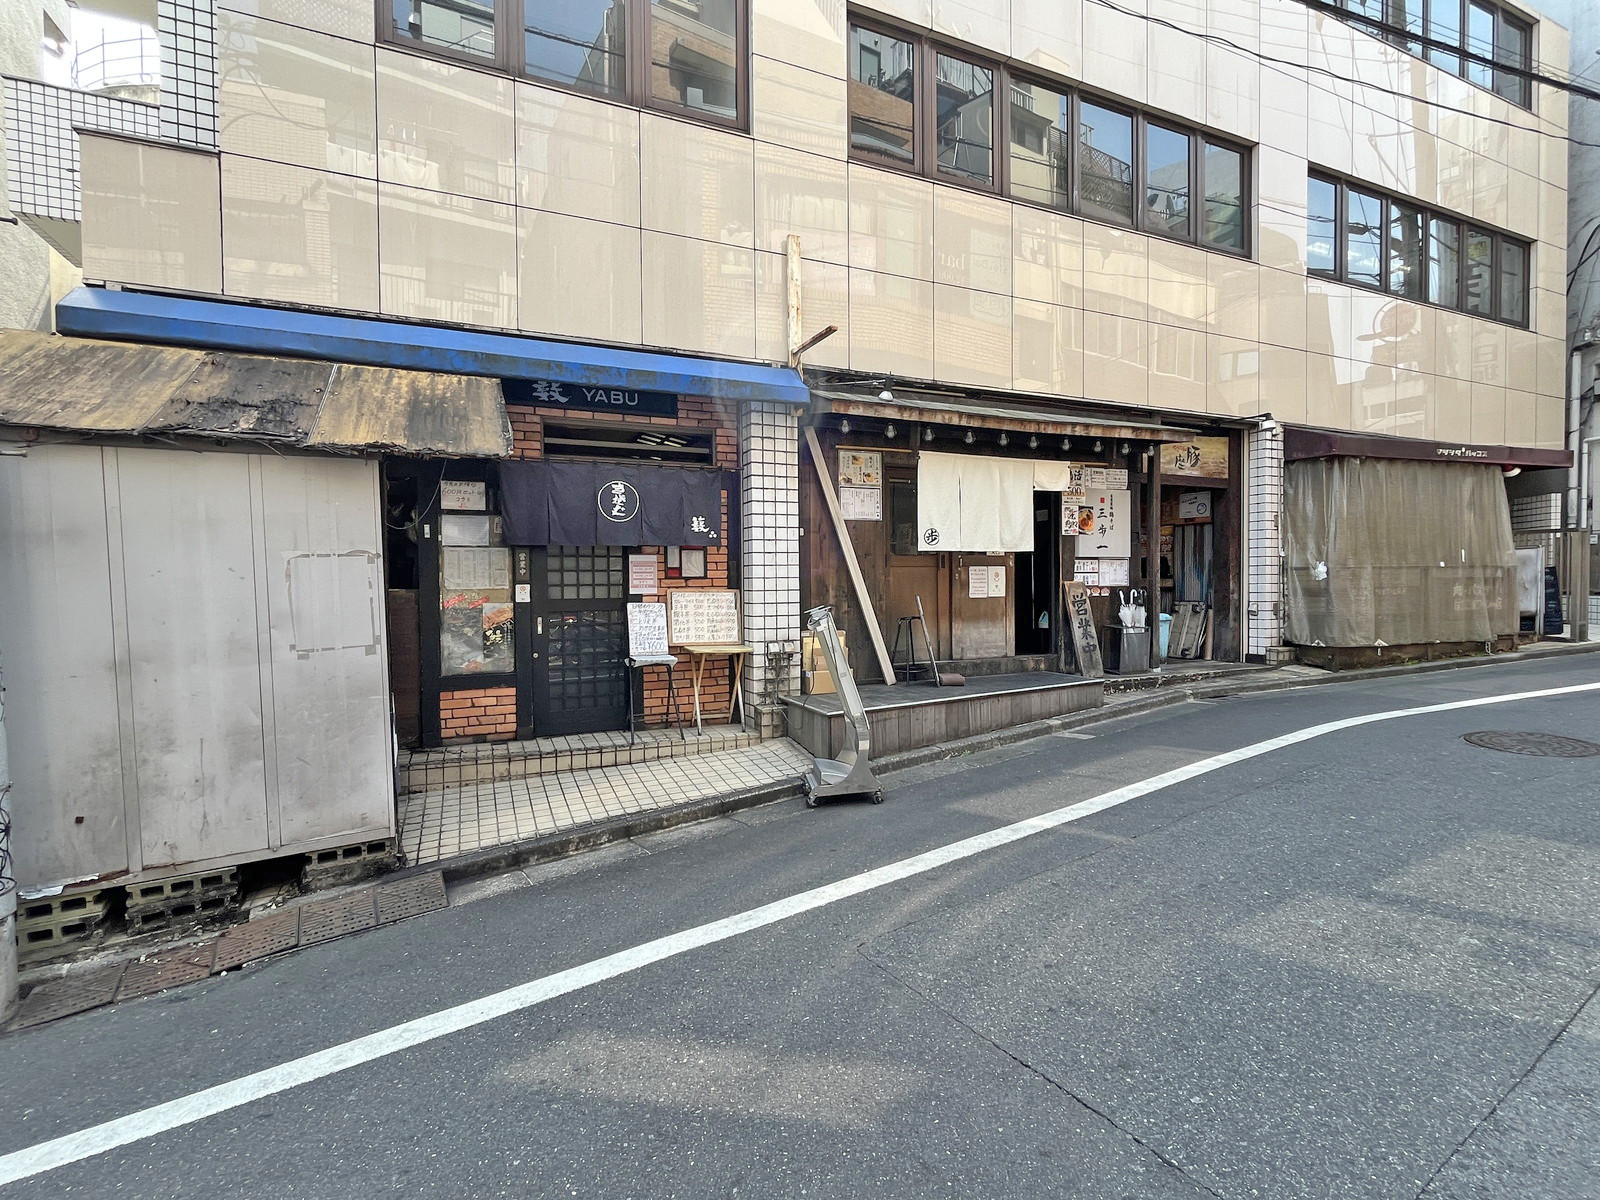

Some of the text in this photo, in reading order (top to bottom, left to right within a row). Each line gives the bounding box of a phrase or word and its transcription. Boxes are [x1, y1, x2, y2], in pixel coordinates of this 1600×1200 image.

[582, 388, 639, 406] YABU
[924, 528, 939, 546] 歩
[1096, 507, 1109, 549] 三歩一
[518, 552, 527, 576] 営業中
[1072, 593, 1097, 664] 営業中
